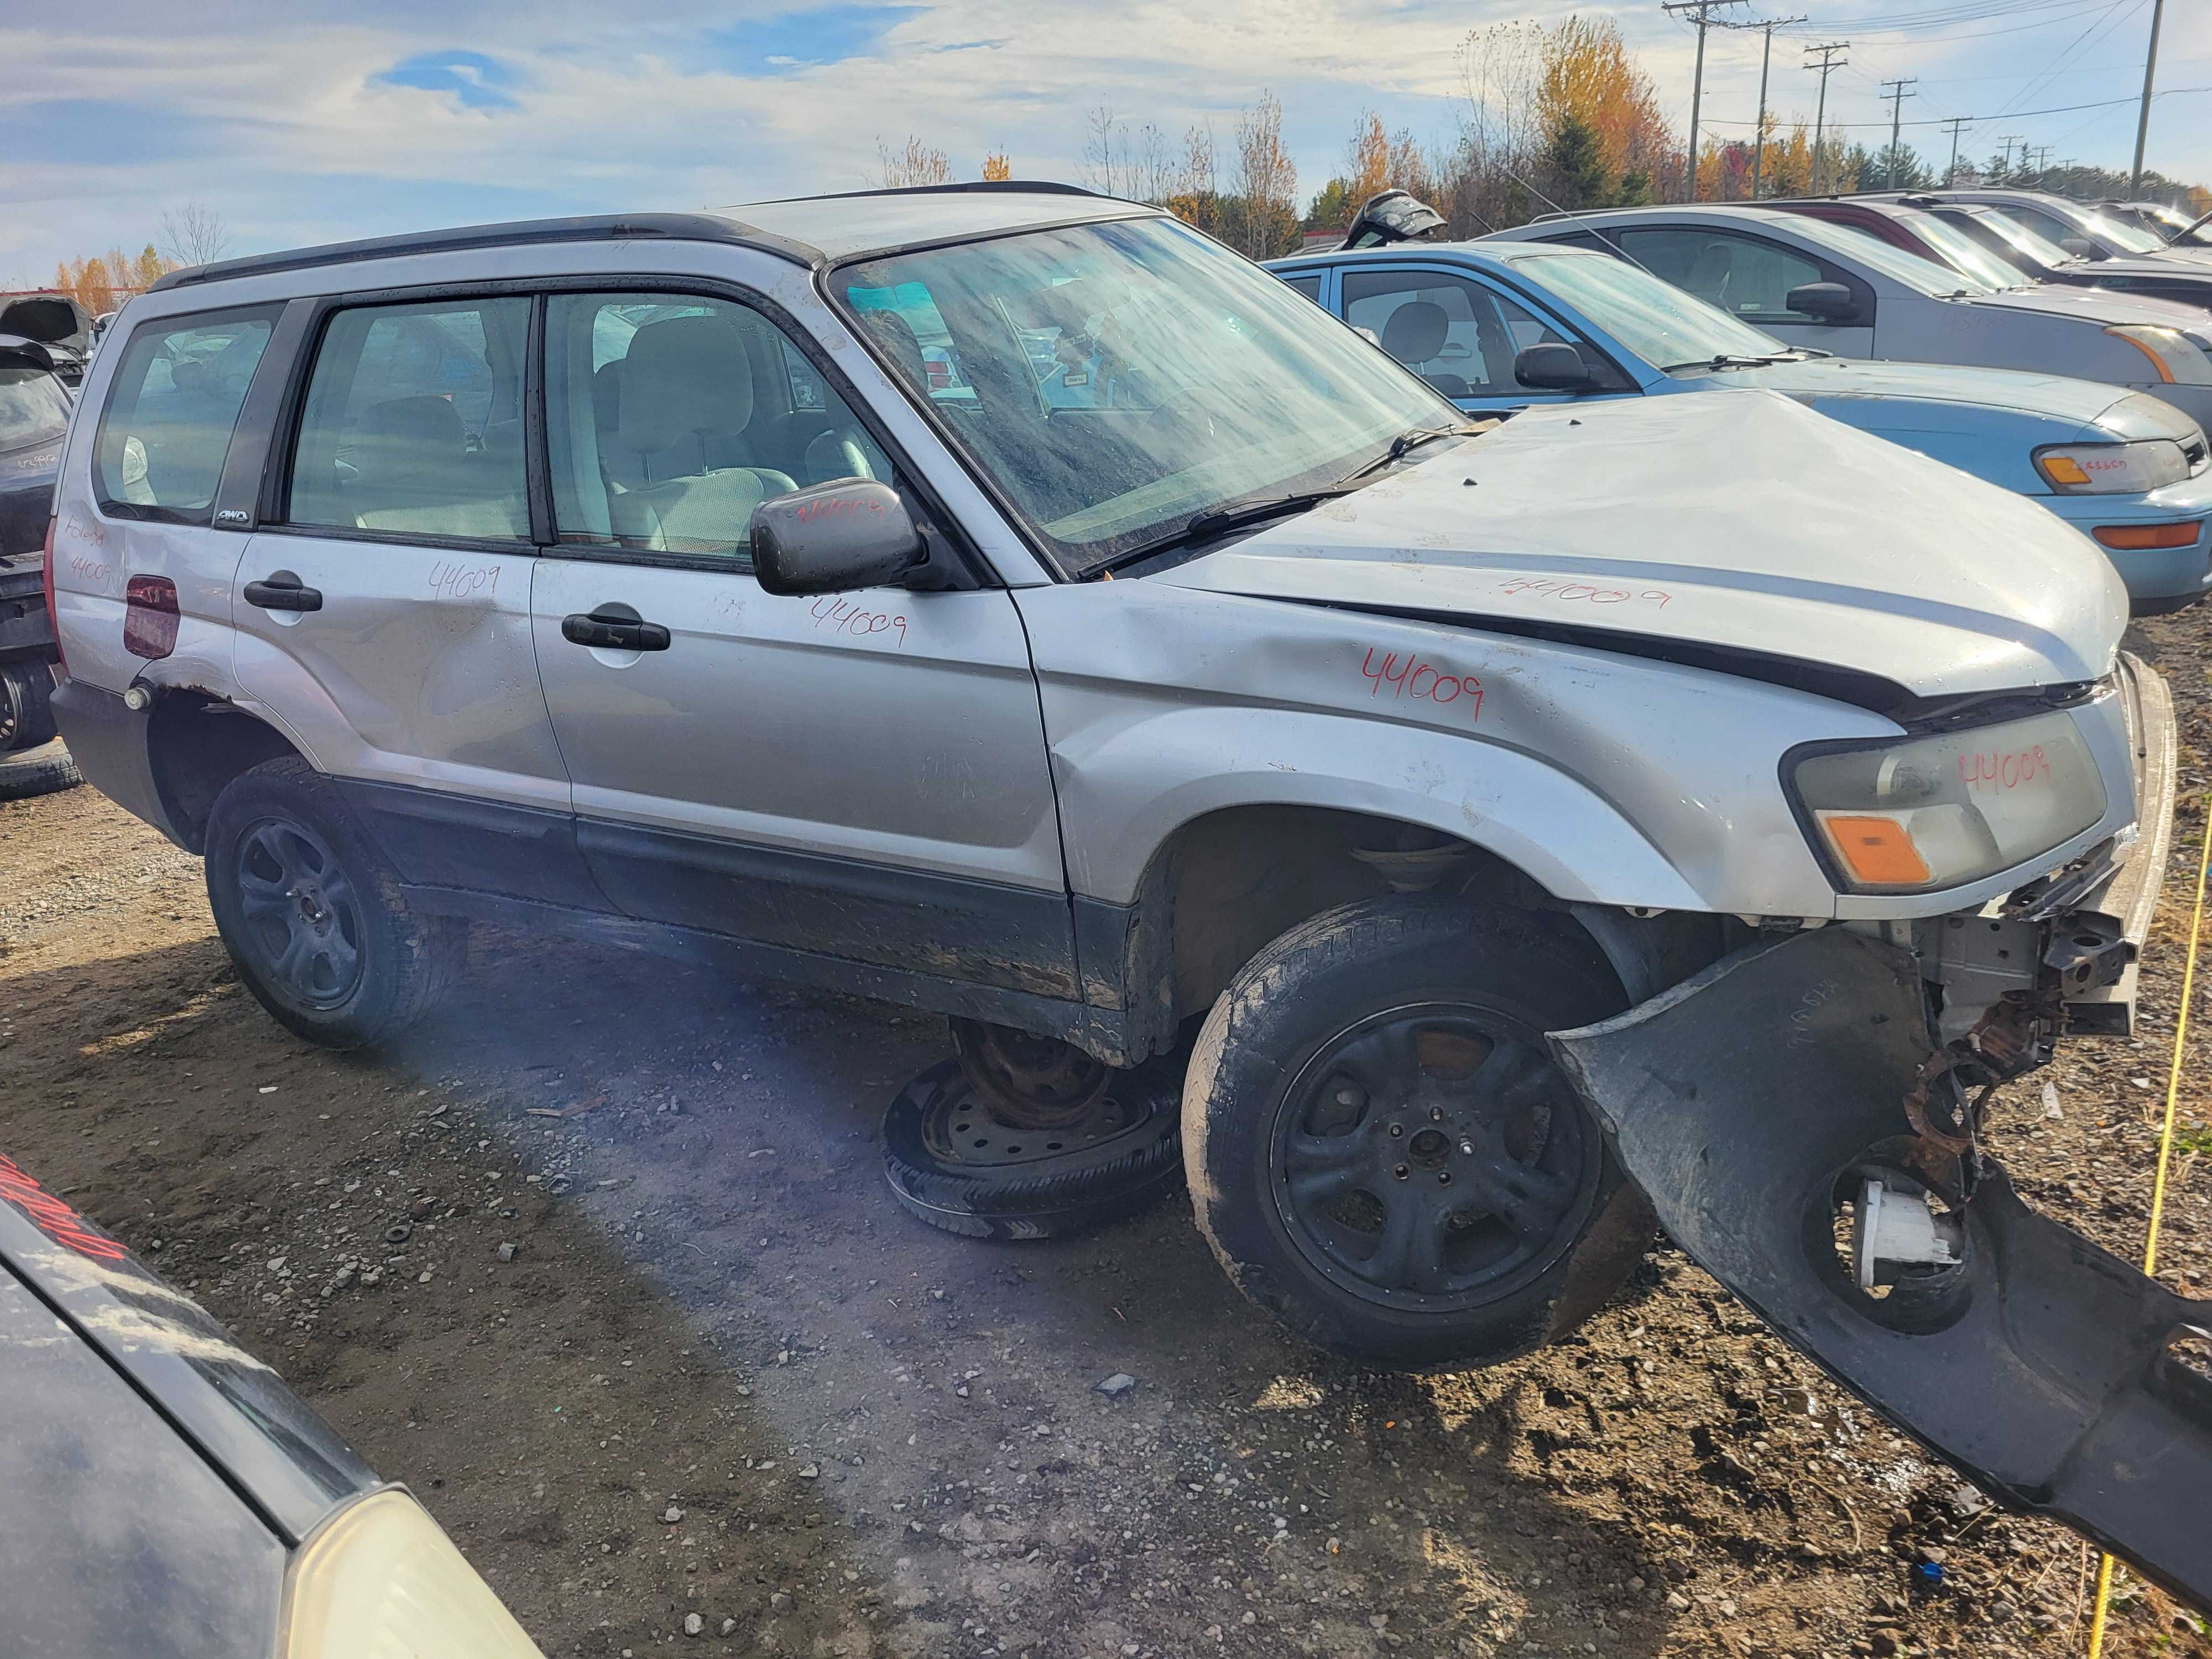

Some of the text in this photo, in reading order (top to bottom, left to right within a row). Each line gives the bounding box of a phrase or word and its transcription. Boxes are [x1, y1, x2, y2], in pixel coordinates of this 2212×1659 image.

[217, 510, 248, 521] AWD
[429, 560, 501, 602] 44009
[1499, 577, 1672, 609] 44009
[810, 597, 907, 649] 44009
[1362, 646, 1484, 723] 44009
[1958, 744, 2054, 797] 44009
